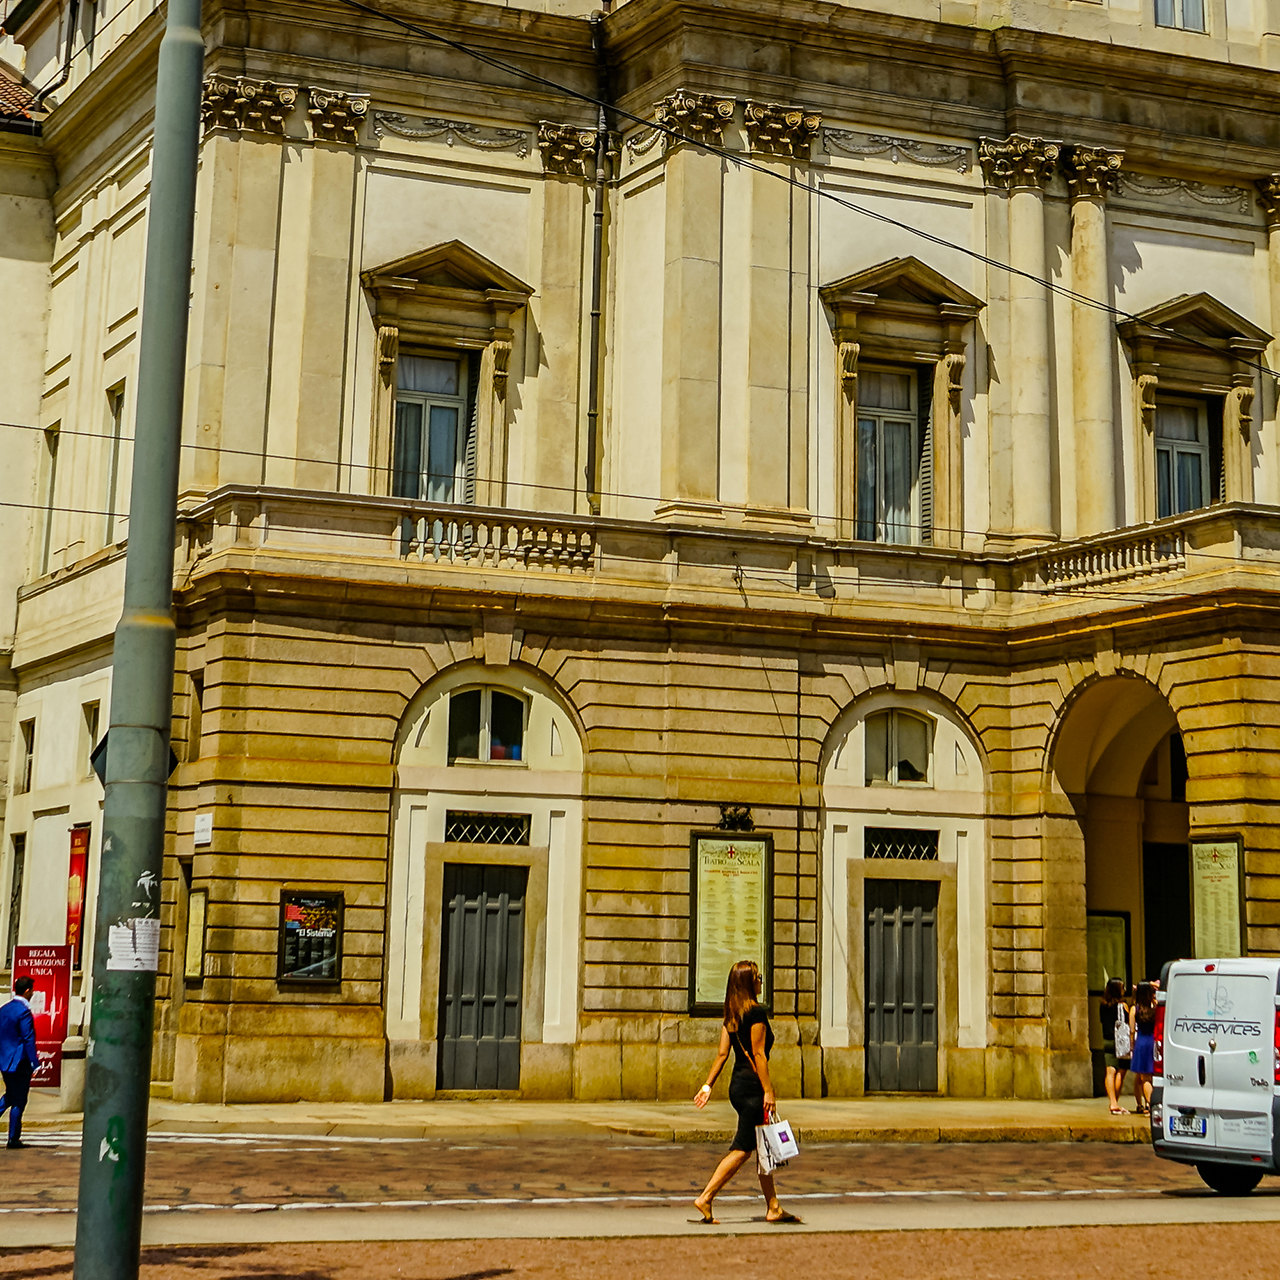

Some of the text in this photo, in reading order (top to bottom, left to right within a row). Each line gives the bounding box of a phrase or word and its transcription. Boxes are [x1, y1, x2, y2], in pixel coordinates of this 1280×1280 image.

[737, 857, 760, 867] SCALA
[28, 949, 56, 958] REGALA
[18, 958, 66, 967] UN'EMOZIONE
[30, 967, 53, 976] UNICA
